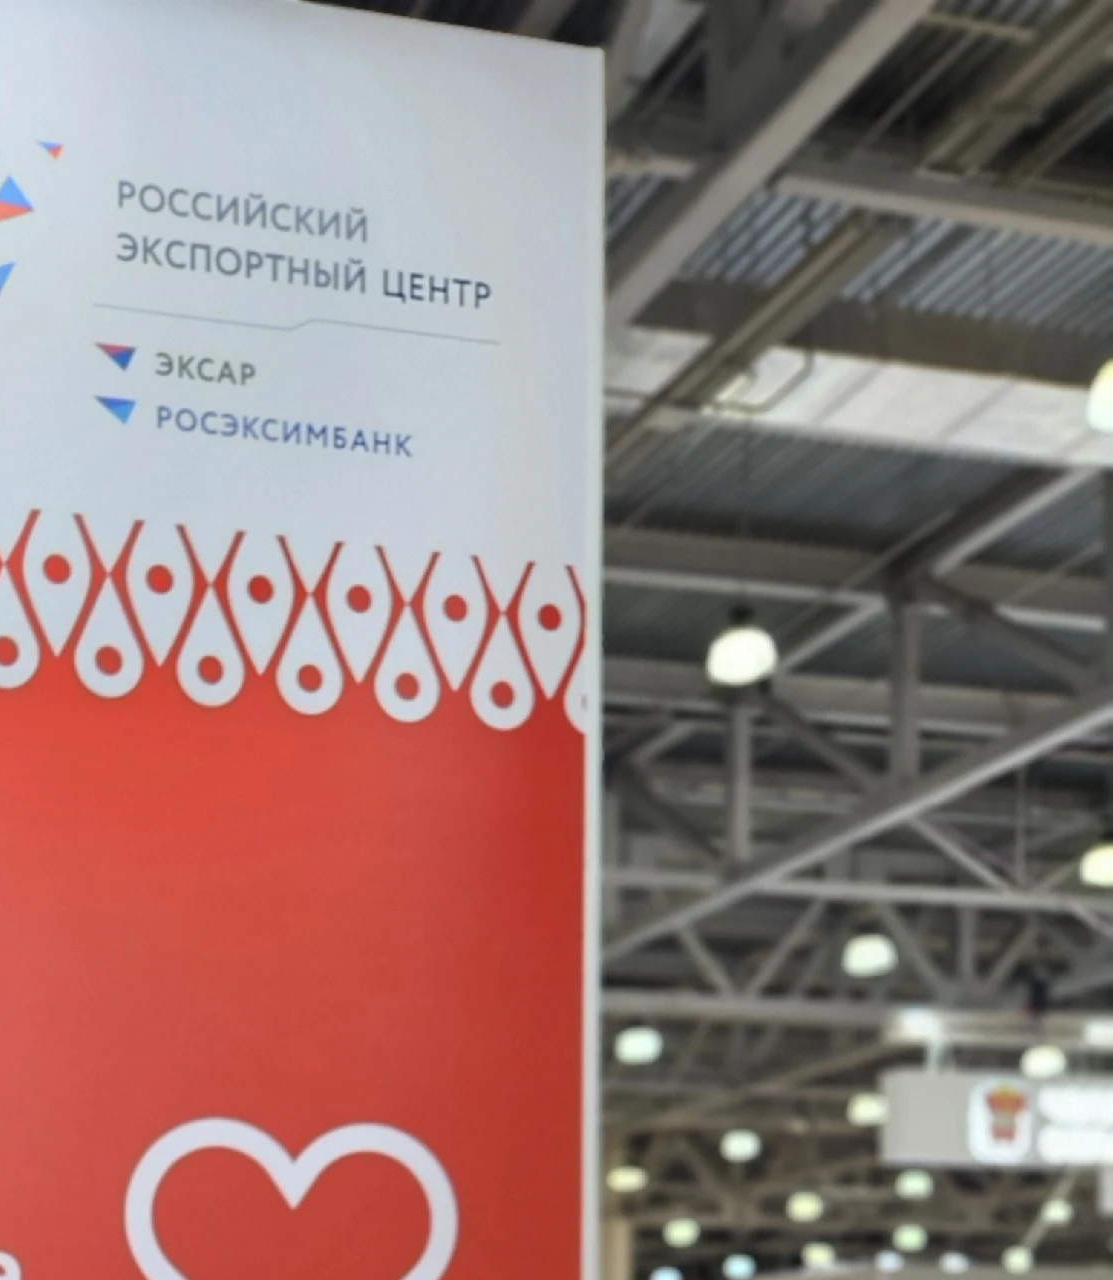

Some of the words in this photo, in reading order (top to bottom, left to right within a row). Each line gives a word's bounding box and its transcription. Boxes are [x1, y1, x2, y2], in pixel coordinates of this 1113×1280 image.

[116, 179, 369, 244] РОССИЙСКИЙ
[116, 232, 367, 295] ЭКСПОРТНЫЙ
[382, 269, 493, 310] ЦЕНТР
[154, 352, 257, 387] ЭКСАР
[155, 405, 414, 458] РОСЭКСИМБАНК
